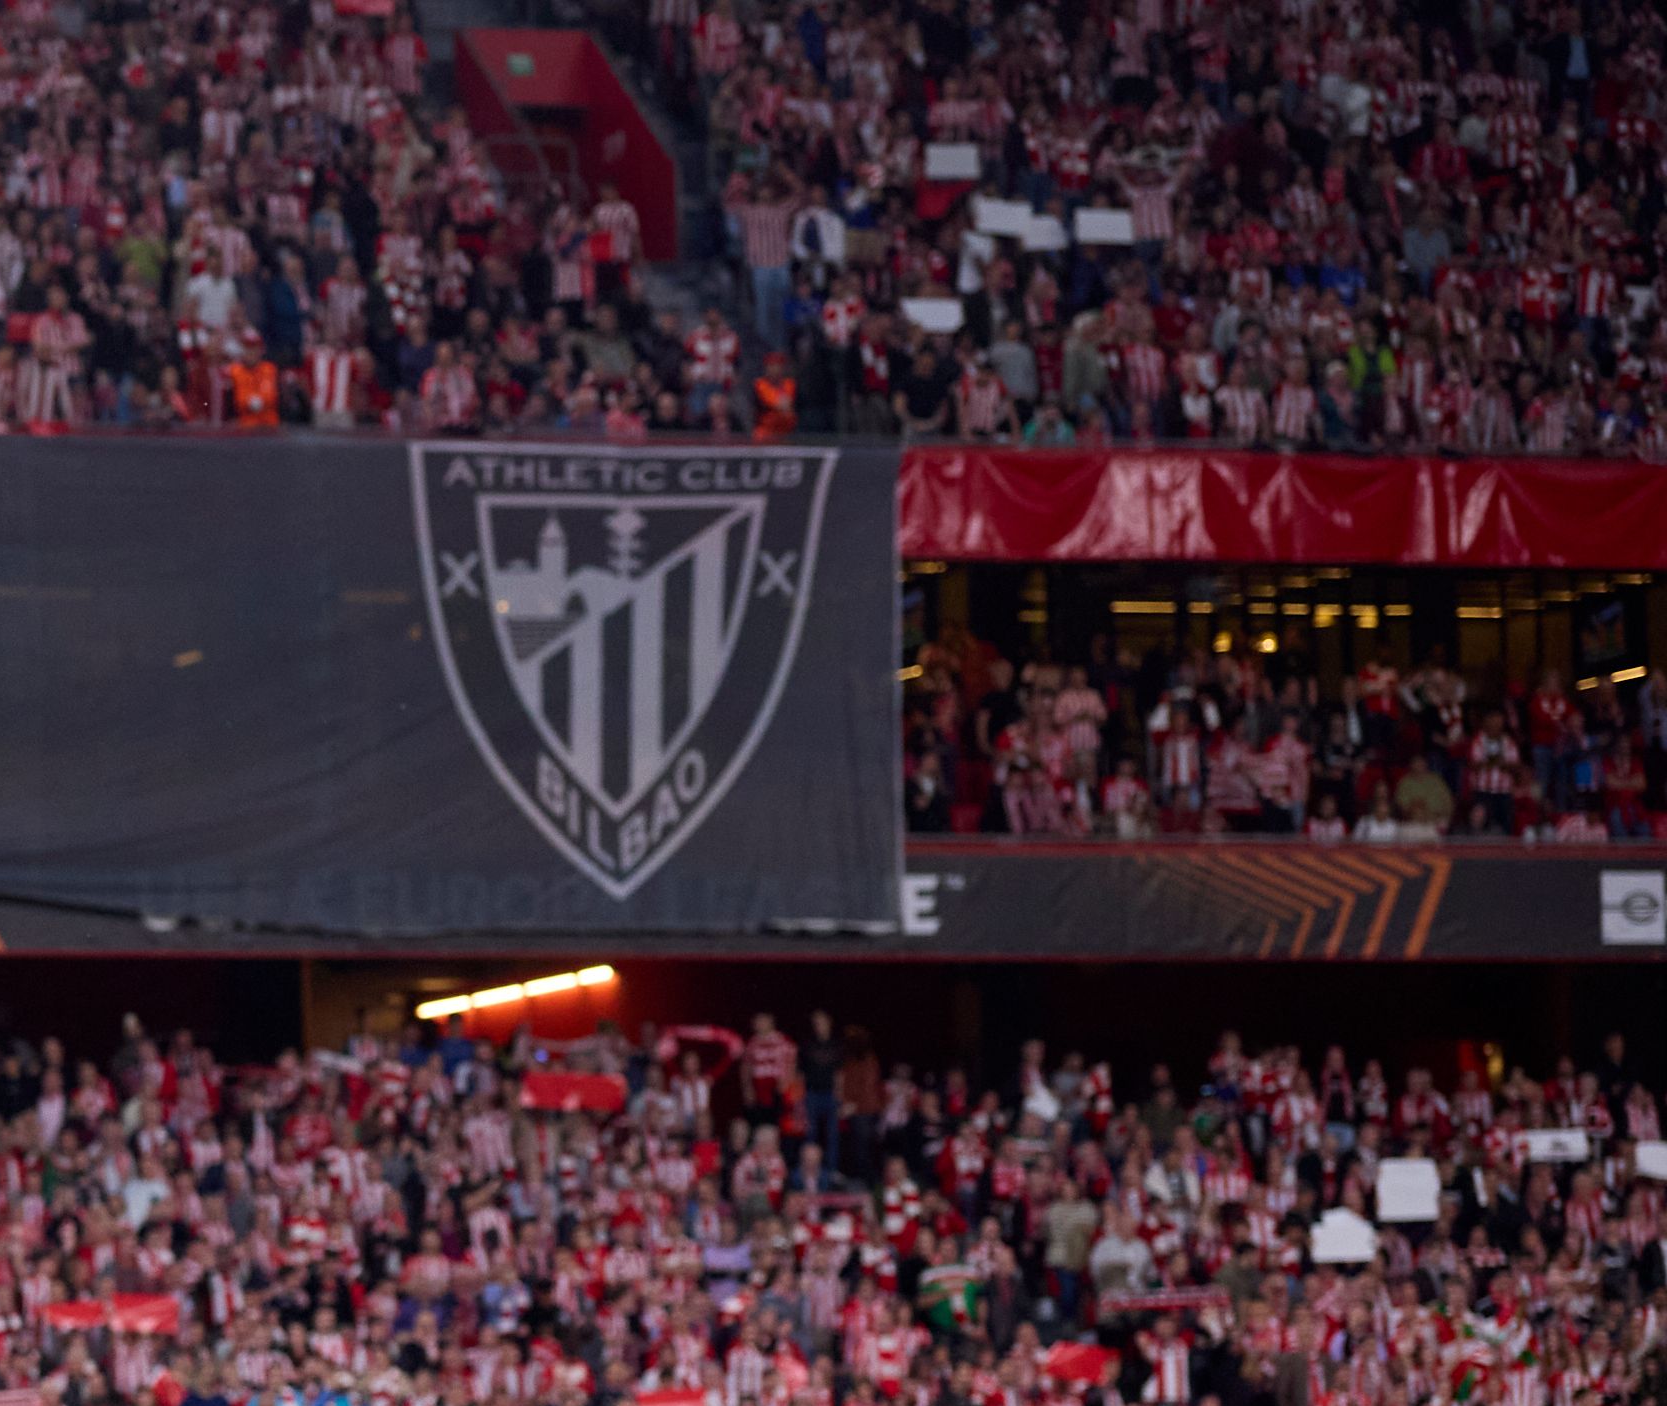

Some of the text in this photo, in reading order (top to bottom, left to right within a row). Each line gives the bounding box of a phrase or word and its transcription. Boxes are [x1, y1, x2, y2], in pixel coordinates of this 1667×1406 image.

[443, 459, 804, 491] ATHLETIC CLUB
[536, 748, 707, 872] BILBAO
